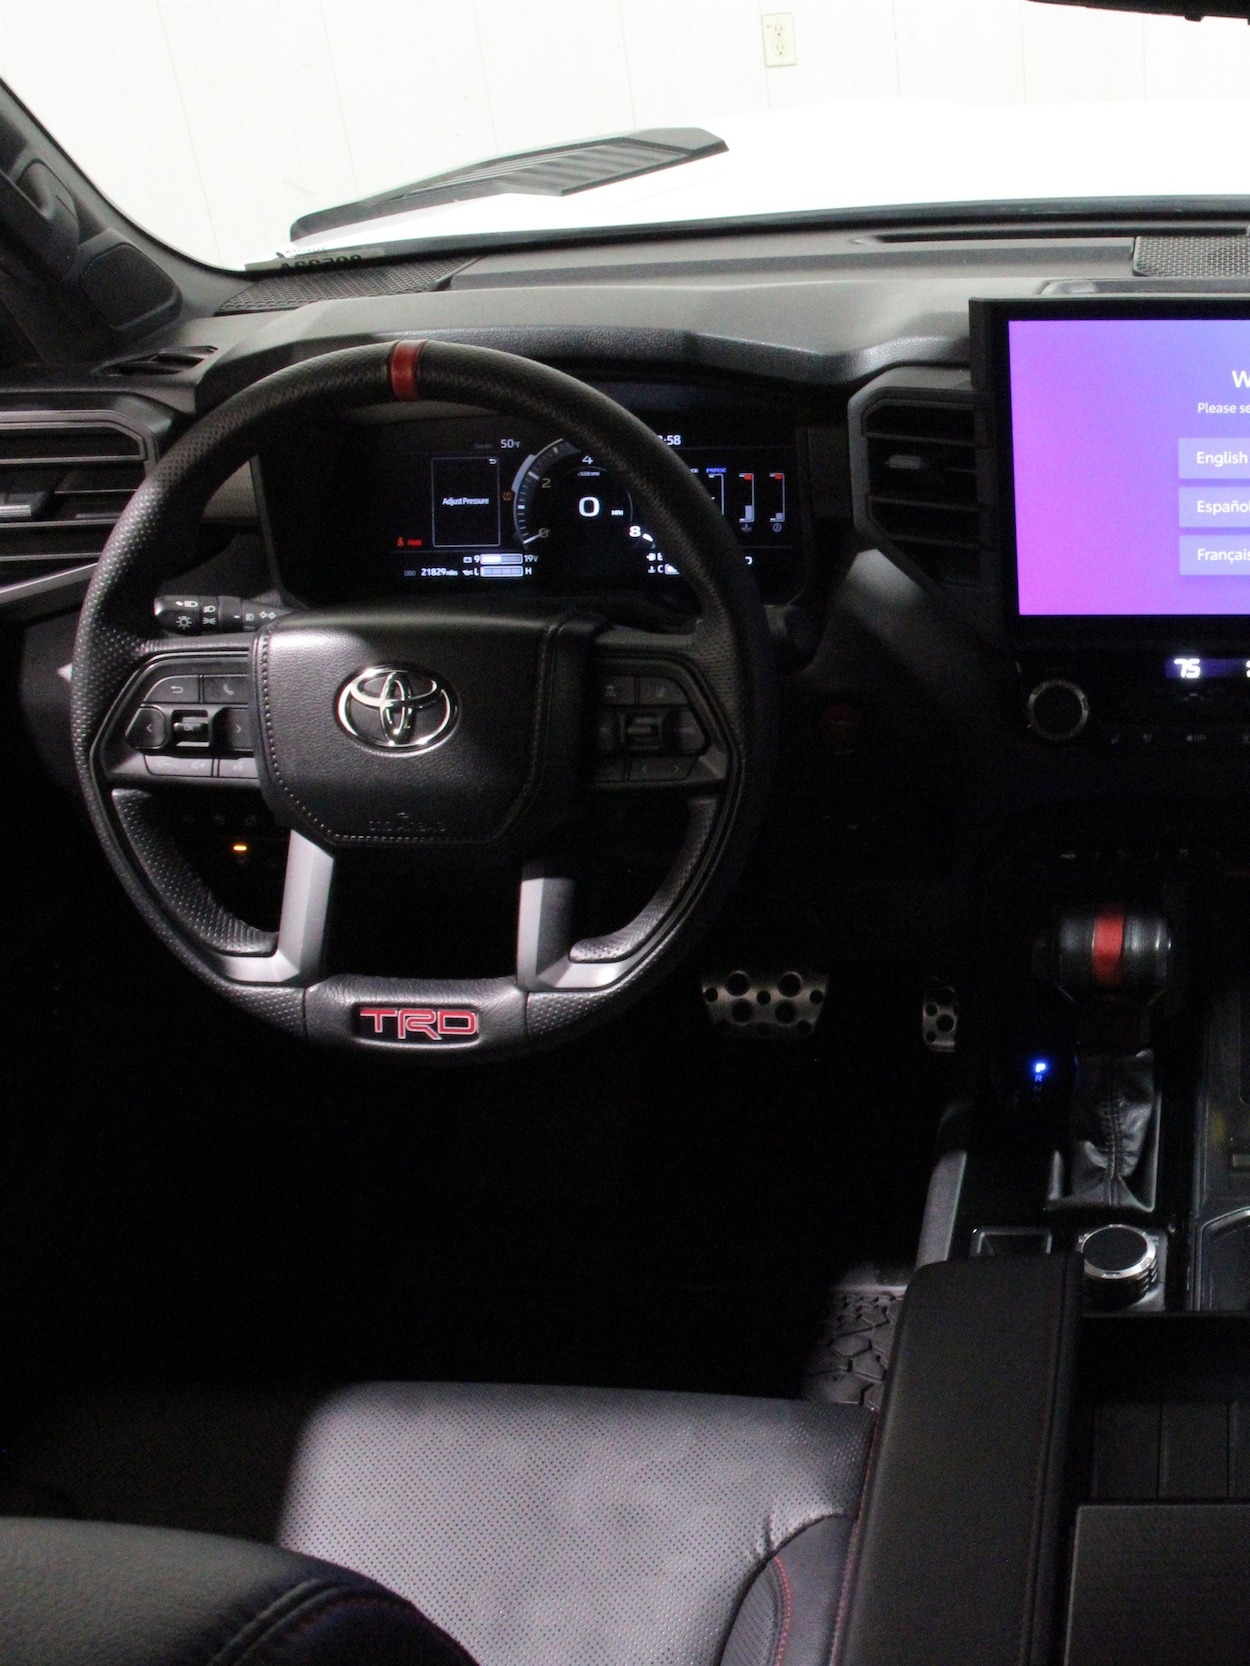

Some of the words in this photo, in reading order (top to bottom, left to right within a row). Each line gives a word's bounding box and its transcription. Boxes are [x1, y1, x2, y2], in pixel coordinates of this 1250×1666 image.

[1197, 402, 1237, 414] Please
[581, 455, 594, 465] 4
[1196, 451, 1249, 468] English
[541, 477, 552, 489] 2
[442, 497, 463, 507] Adjust
[463, 497, 490, 505] Pressure
[578, 496, 600, 518] 0
[629, 525, 642, 538] 8
[524, 567, 532, 576] H
[1173, 657, 1201, 679] 75
[360, 1007, 479, 1041] TRD
